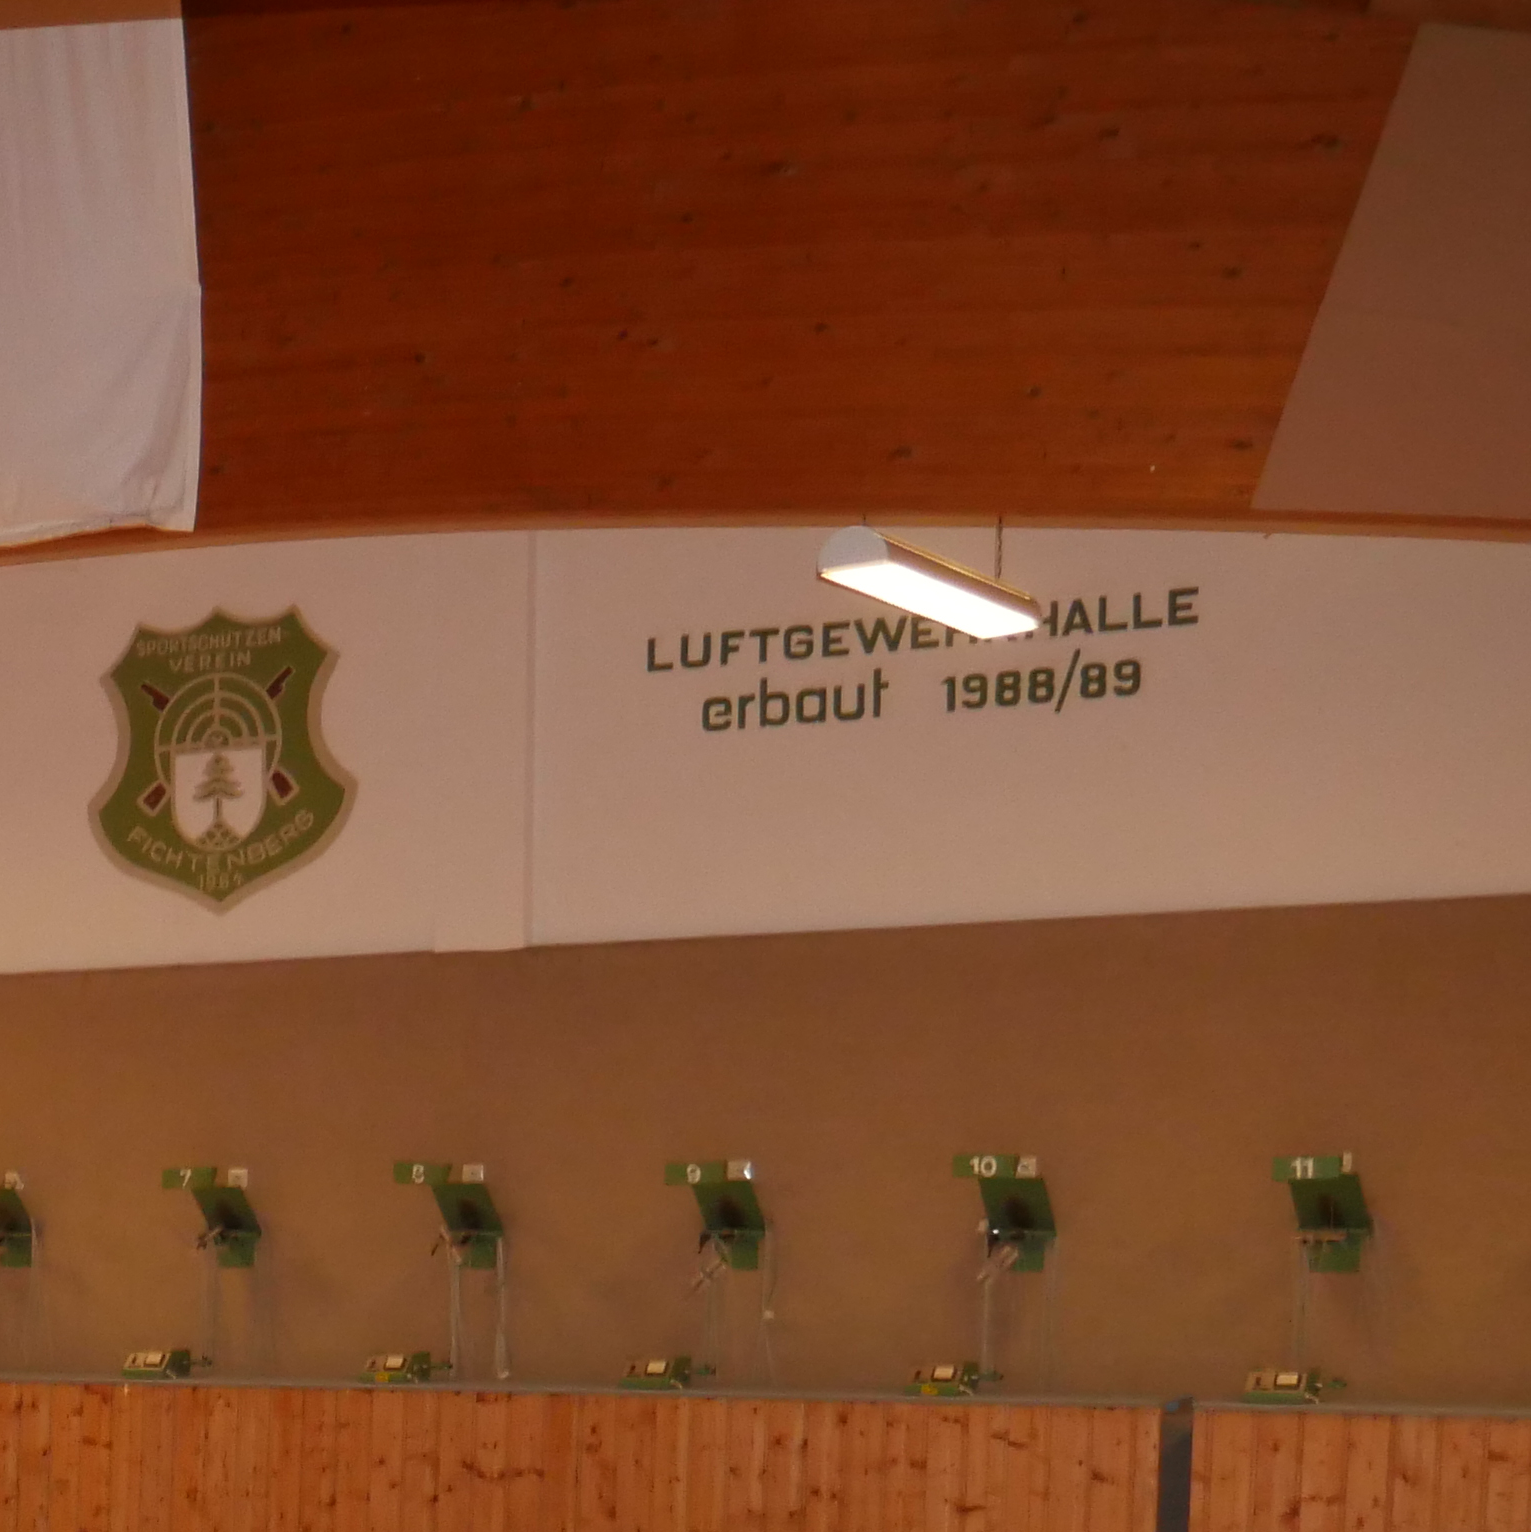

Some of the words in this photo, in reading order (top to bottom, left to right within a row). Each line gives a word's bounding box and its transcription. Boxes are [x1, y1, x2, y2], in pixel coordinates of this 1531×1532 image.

[645, 586, 1200, 673] LUFTGEWEHALLE
[168, 649, 252, 674] VEREIN
[701, 667, 890, 732] erbaut
[940, 648, 1142, 713] 1988/89
[126, 808, 315, 874] FICHTENBERG
[179, 1168, 192, 1190] 7
[969, 1155, 998, 1178] 10
[1289, 1156, 1315, 1180] 11
